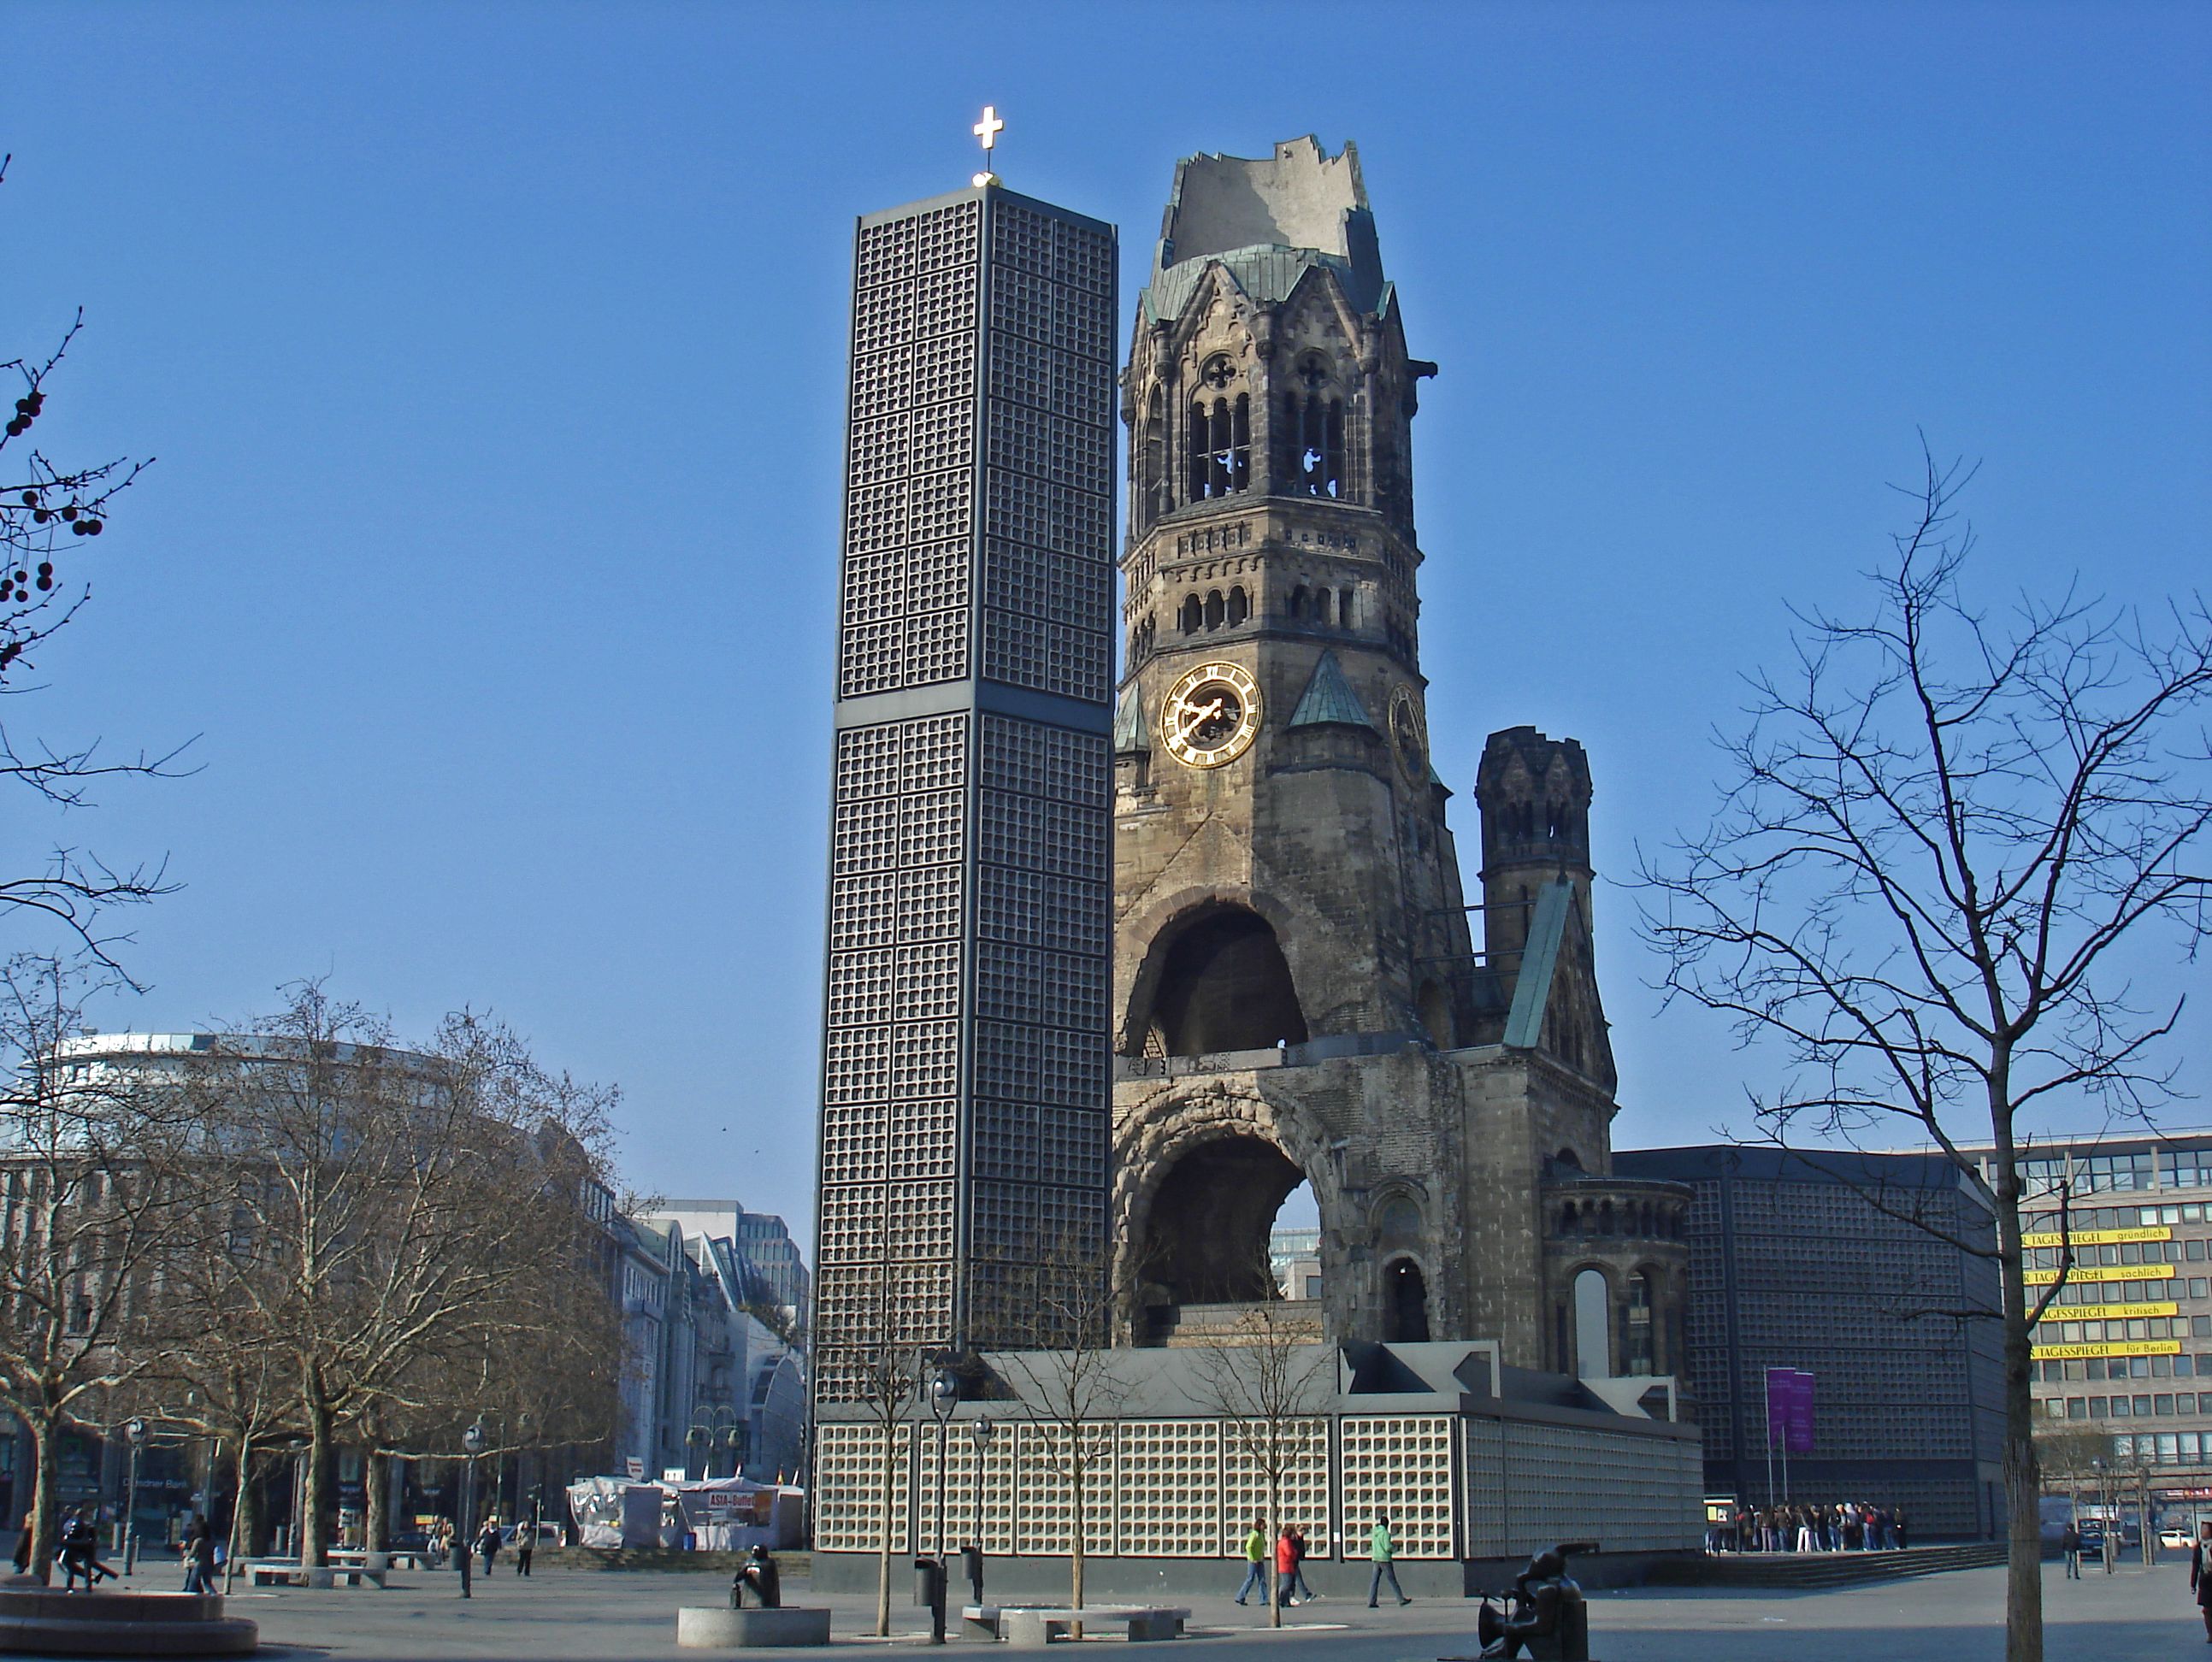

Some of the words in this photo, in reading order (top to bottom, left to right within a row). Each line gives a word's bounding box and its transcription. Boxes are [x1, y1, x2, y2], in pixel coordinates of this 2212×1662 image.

[2032, 1232, 2101, 1246] TAGESPIEGEL
[2118, 1228, 2164, 1241] gründlich
[2034, 1270, 2104, 1282] TAGEPIEGEL
[2121, 1267, 2162, 1278] sachlich
[2040, 1306, 2107, 1320] AGESSPIEGEL
[2124, 1305, 2159, 1316] kritisch
[2040, 1345, 2110, 1358] TAGESSPIEGEL
[2126, 1345, 2140, 1353] für
[2144, 1343, 2174, 1353] Berlin
